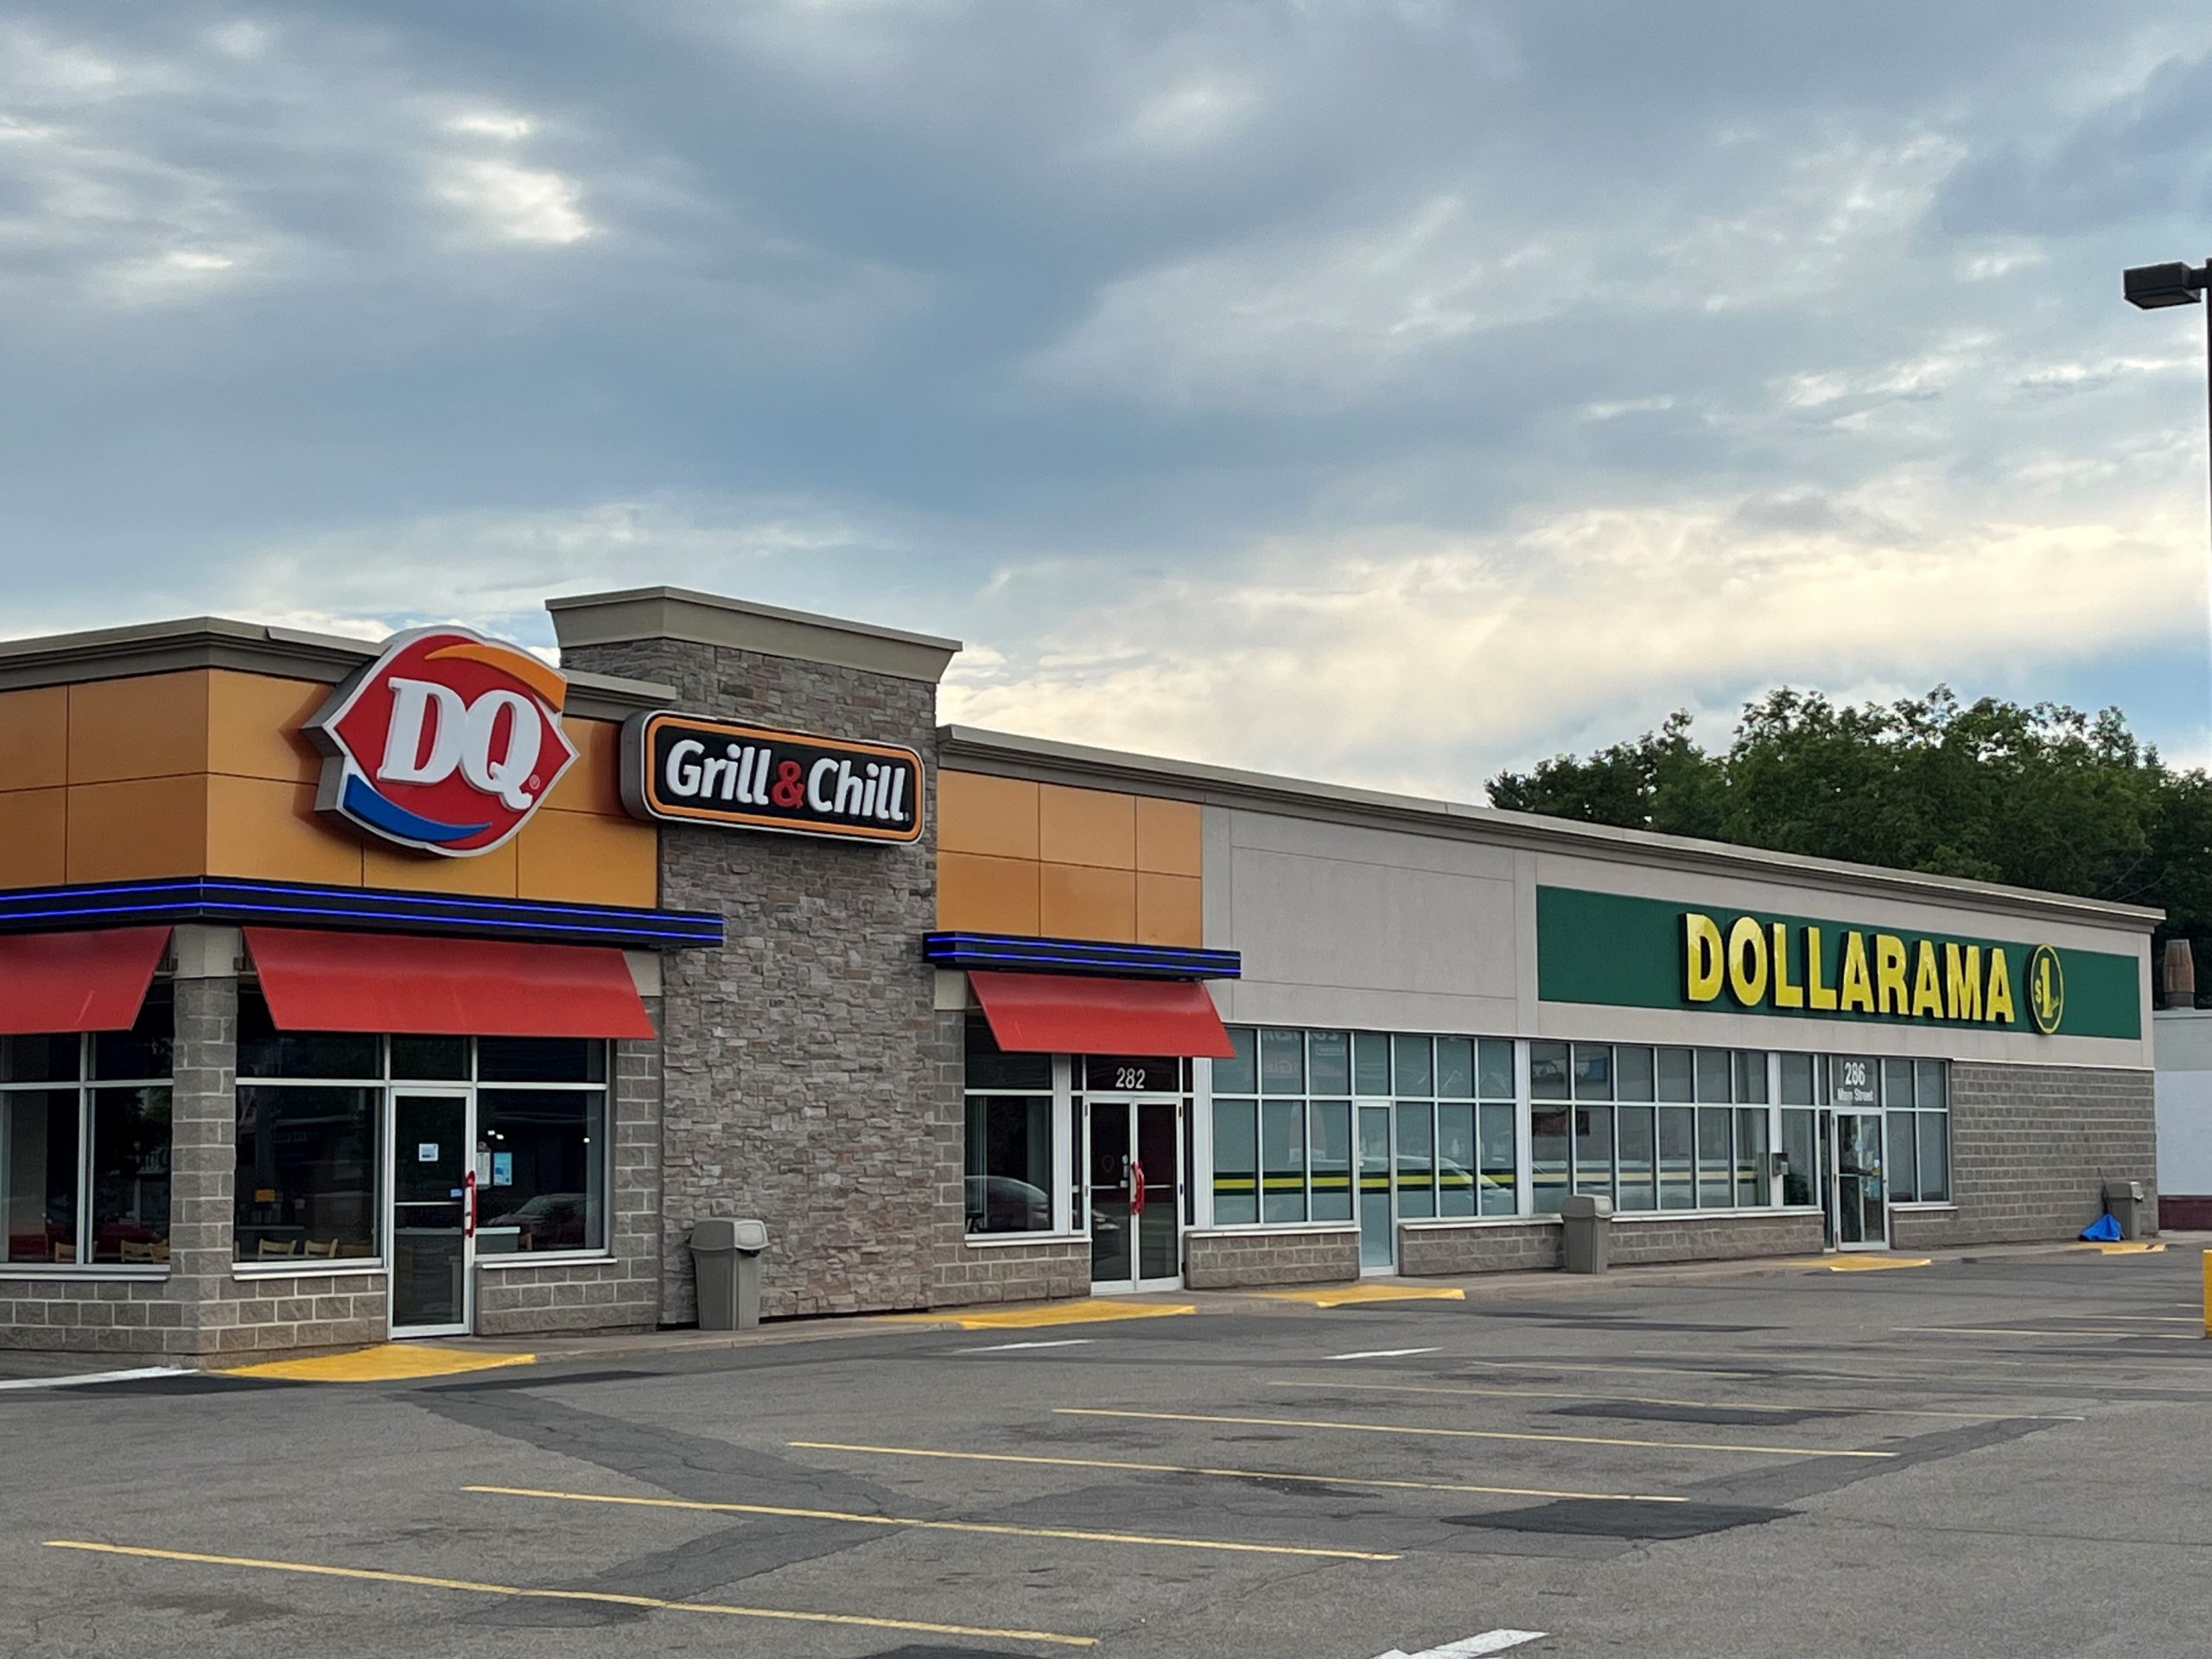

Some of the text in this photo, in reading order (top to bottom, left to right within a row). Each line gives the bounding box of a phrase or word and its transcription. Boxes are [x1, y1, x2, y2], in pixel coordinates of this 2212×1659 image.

[377, 677, 542, 810] DQ
[666, 739, 772, 805] Grill
[807, 758, 906, 821] Chill
[1685, 912, 2015, 1023] DOLLARAMA
[1116, 1066, 1146, 1089] 282
[1844, 1062, 1866, 1086] 286
